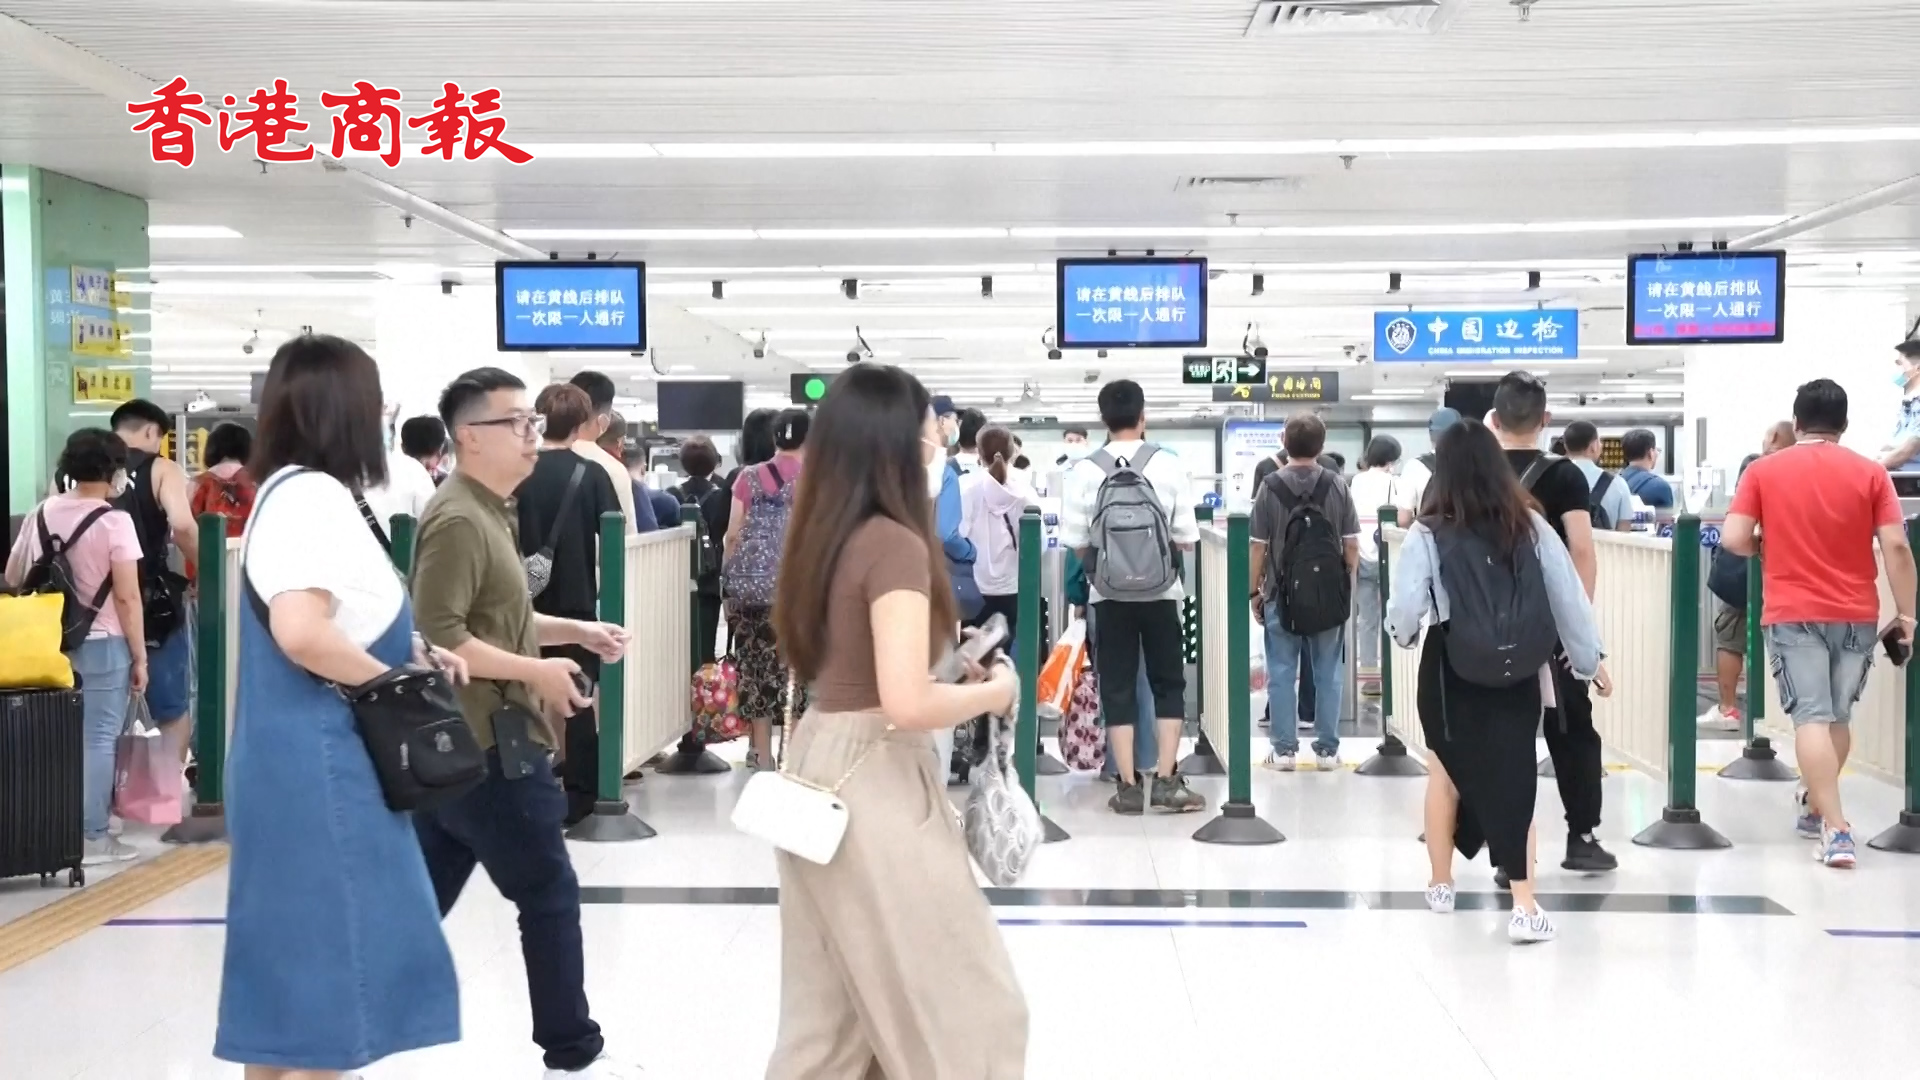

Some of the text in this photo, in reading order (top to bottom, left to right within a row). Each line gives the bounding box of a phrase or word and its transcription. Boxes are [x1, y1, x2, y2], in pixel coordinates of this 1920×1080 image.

[516, 289, 625, 306] 请在黄线后排队
[1076, 286, 1186, 302] 请在黄线后排队
[1647, 280, 1762, 298] 请在黄线后排队
[1076, 306, 1187, 323] 一次限一人通行
[1647, 301, 1762, 318] 一次限一人通行
[516, 310, 625, 327] 一次限一人通行
[1428, 347, 1453, 355] CHINA
[1700, 530, 1719, 545] 20
